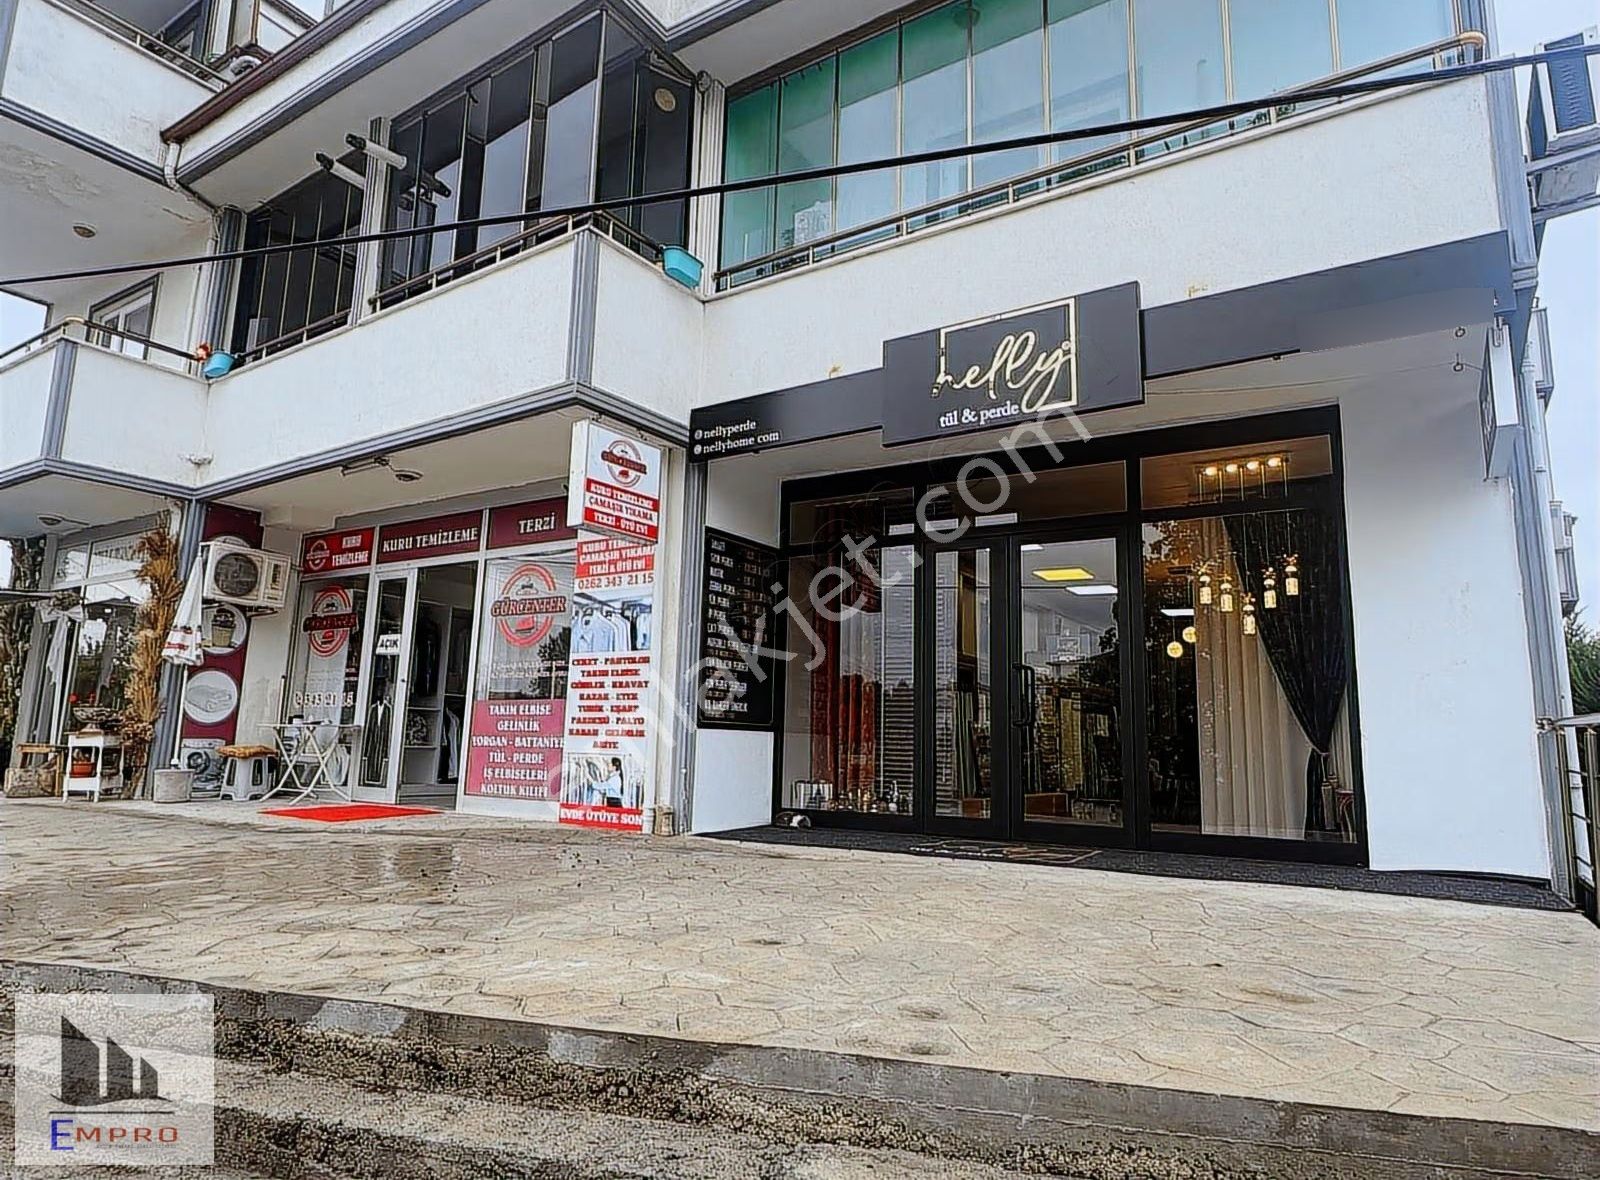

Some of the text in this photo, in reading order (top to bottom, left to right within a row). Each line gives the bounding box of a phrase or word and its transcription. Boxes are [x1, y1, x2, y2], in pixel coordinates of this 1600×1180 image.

[939, 401, 1020, 428] tül & perde
[518, 512, 555, 534] TERZİ
[383, 527, 478, 552] KURU TEMİZLEME
[627, 574, 638, 586] 21
[642, 572, 655, 584] 15
[560, 808, 585, 821] EVDE
